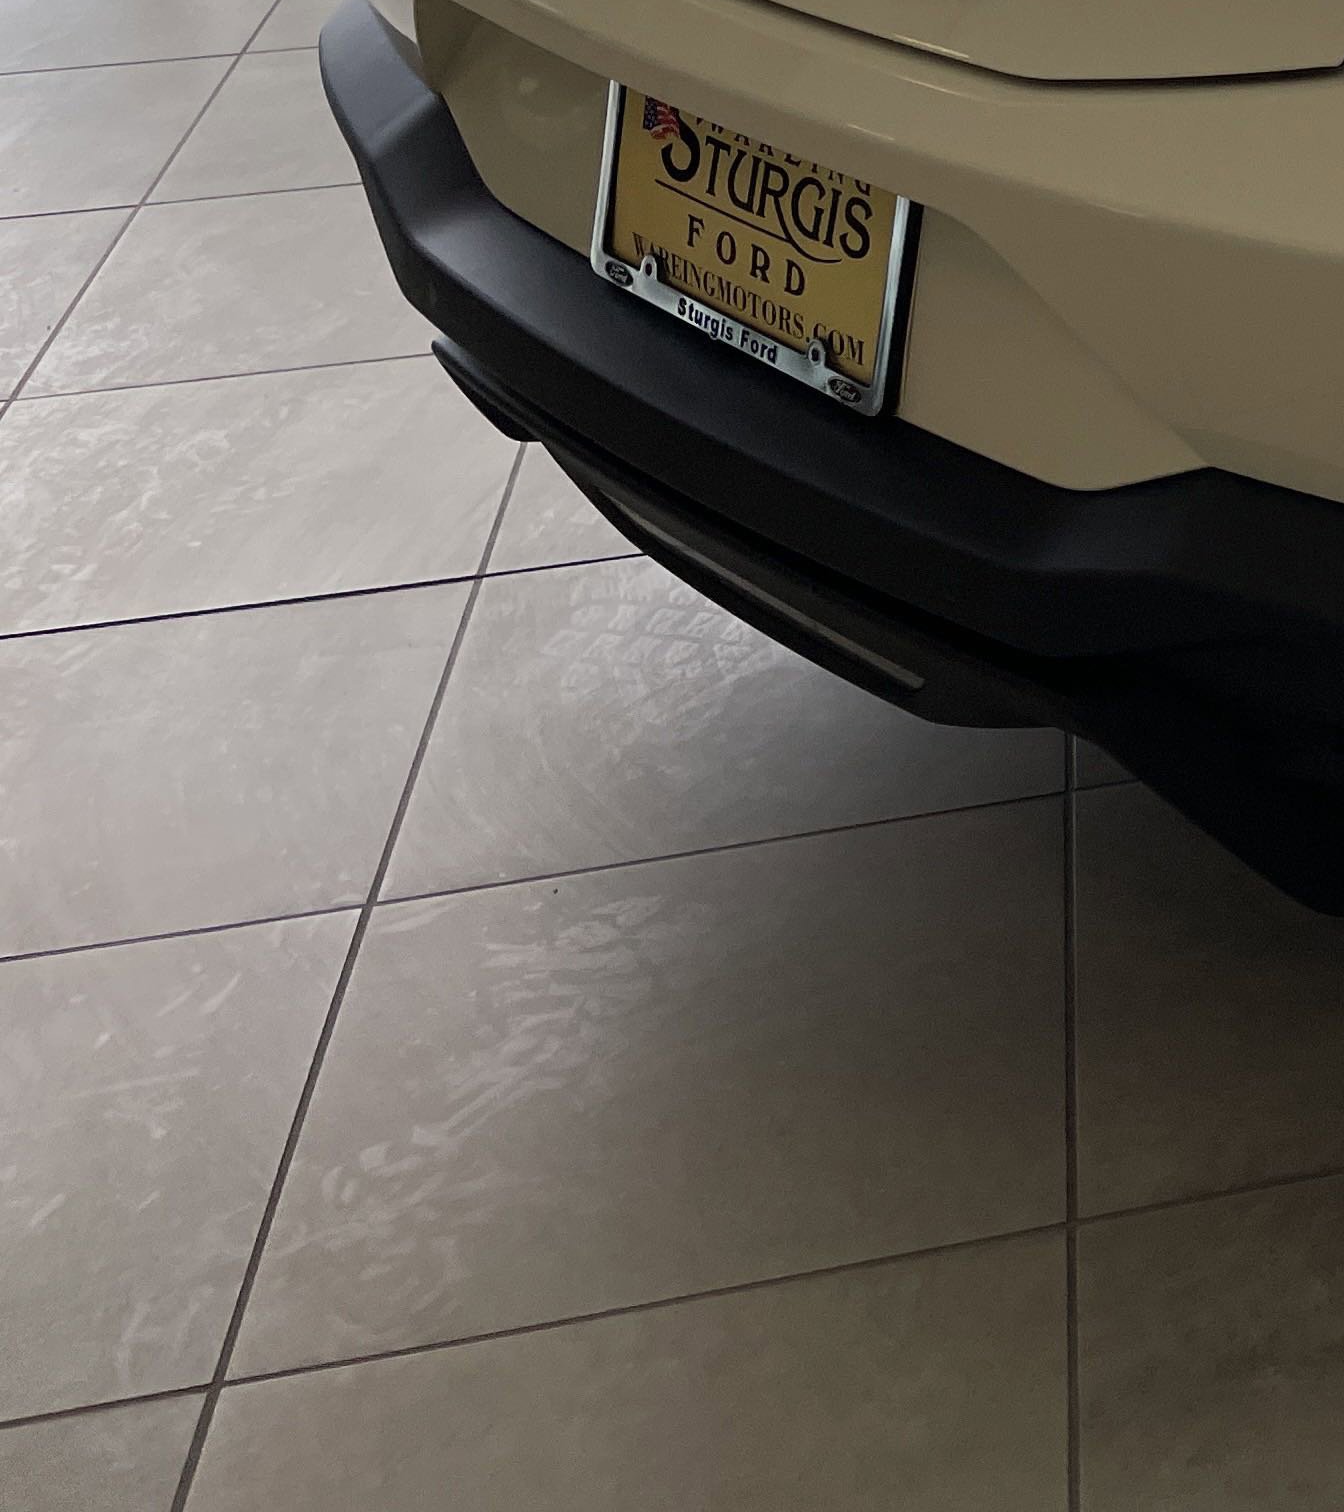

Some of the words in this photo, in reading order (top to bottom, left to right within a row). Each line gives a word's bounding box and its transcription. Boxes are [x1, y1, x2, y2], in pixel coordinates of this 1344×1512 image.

[661, 106, 874, 261] STURGIS
[687, 213, 806, 297] FORD
[677, 296, 734, 339] Sturgis
[740, 328, 778, 365] Ford
